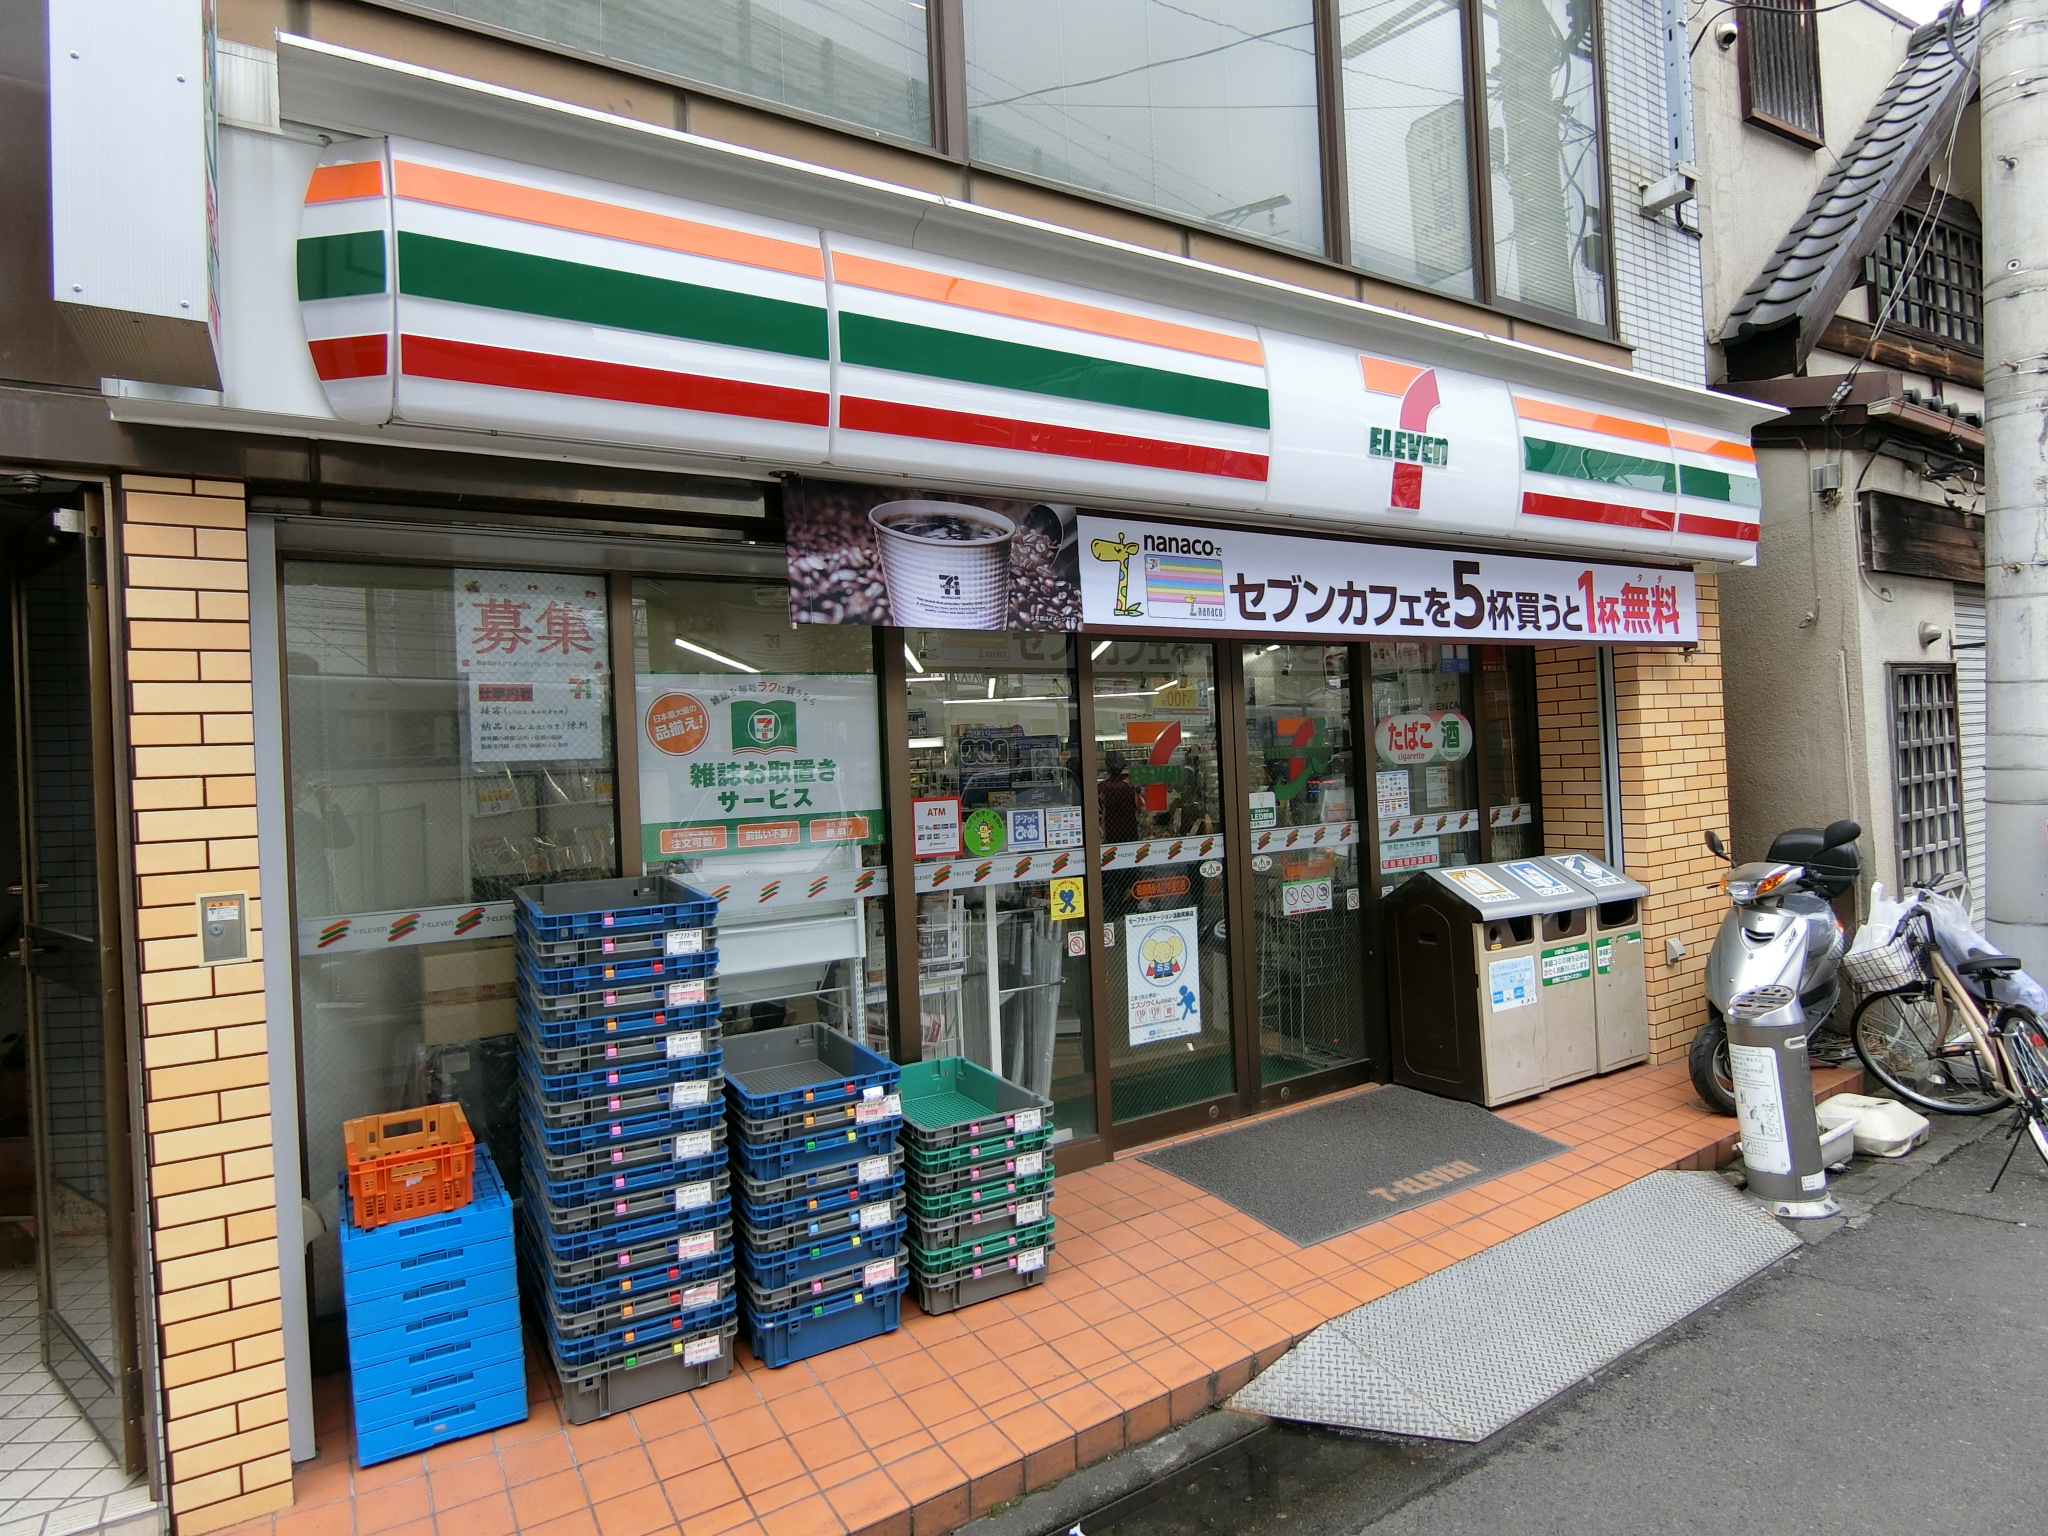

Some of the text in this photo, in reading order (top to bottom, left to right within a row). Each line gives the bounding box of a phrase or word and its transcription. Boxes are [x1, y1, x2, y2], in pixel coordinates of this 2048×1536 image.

[1229, 560, 1680, 635] セブンカフェを5杯買うと1杯無料
[1198, 606, 1223, 618] nanaco
[471, 598, 595, 655] 募集
[653, 704, 697, 722] 日本最大級の
[1388, 720, 1460, 751] たばこ 酒
[1397, 751, 1461, 762] cigarette liquor
[690, 758, 837, 788] 雑誌お取置き
[717, 787, 813, 813] サービス
[927, 807, 946, 817] ATM
[1014, 825, 1039, 840] ぴあ
